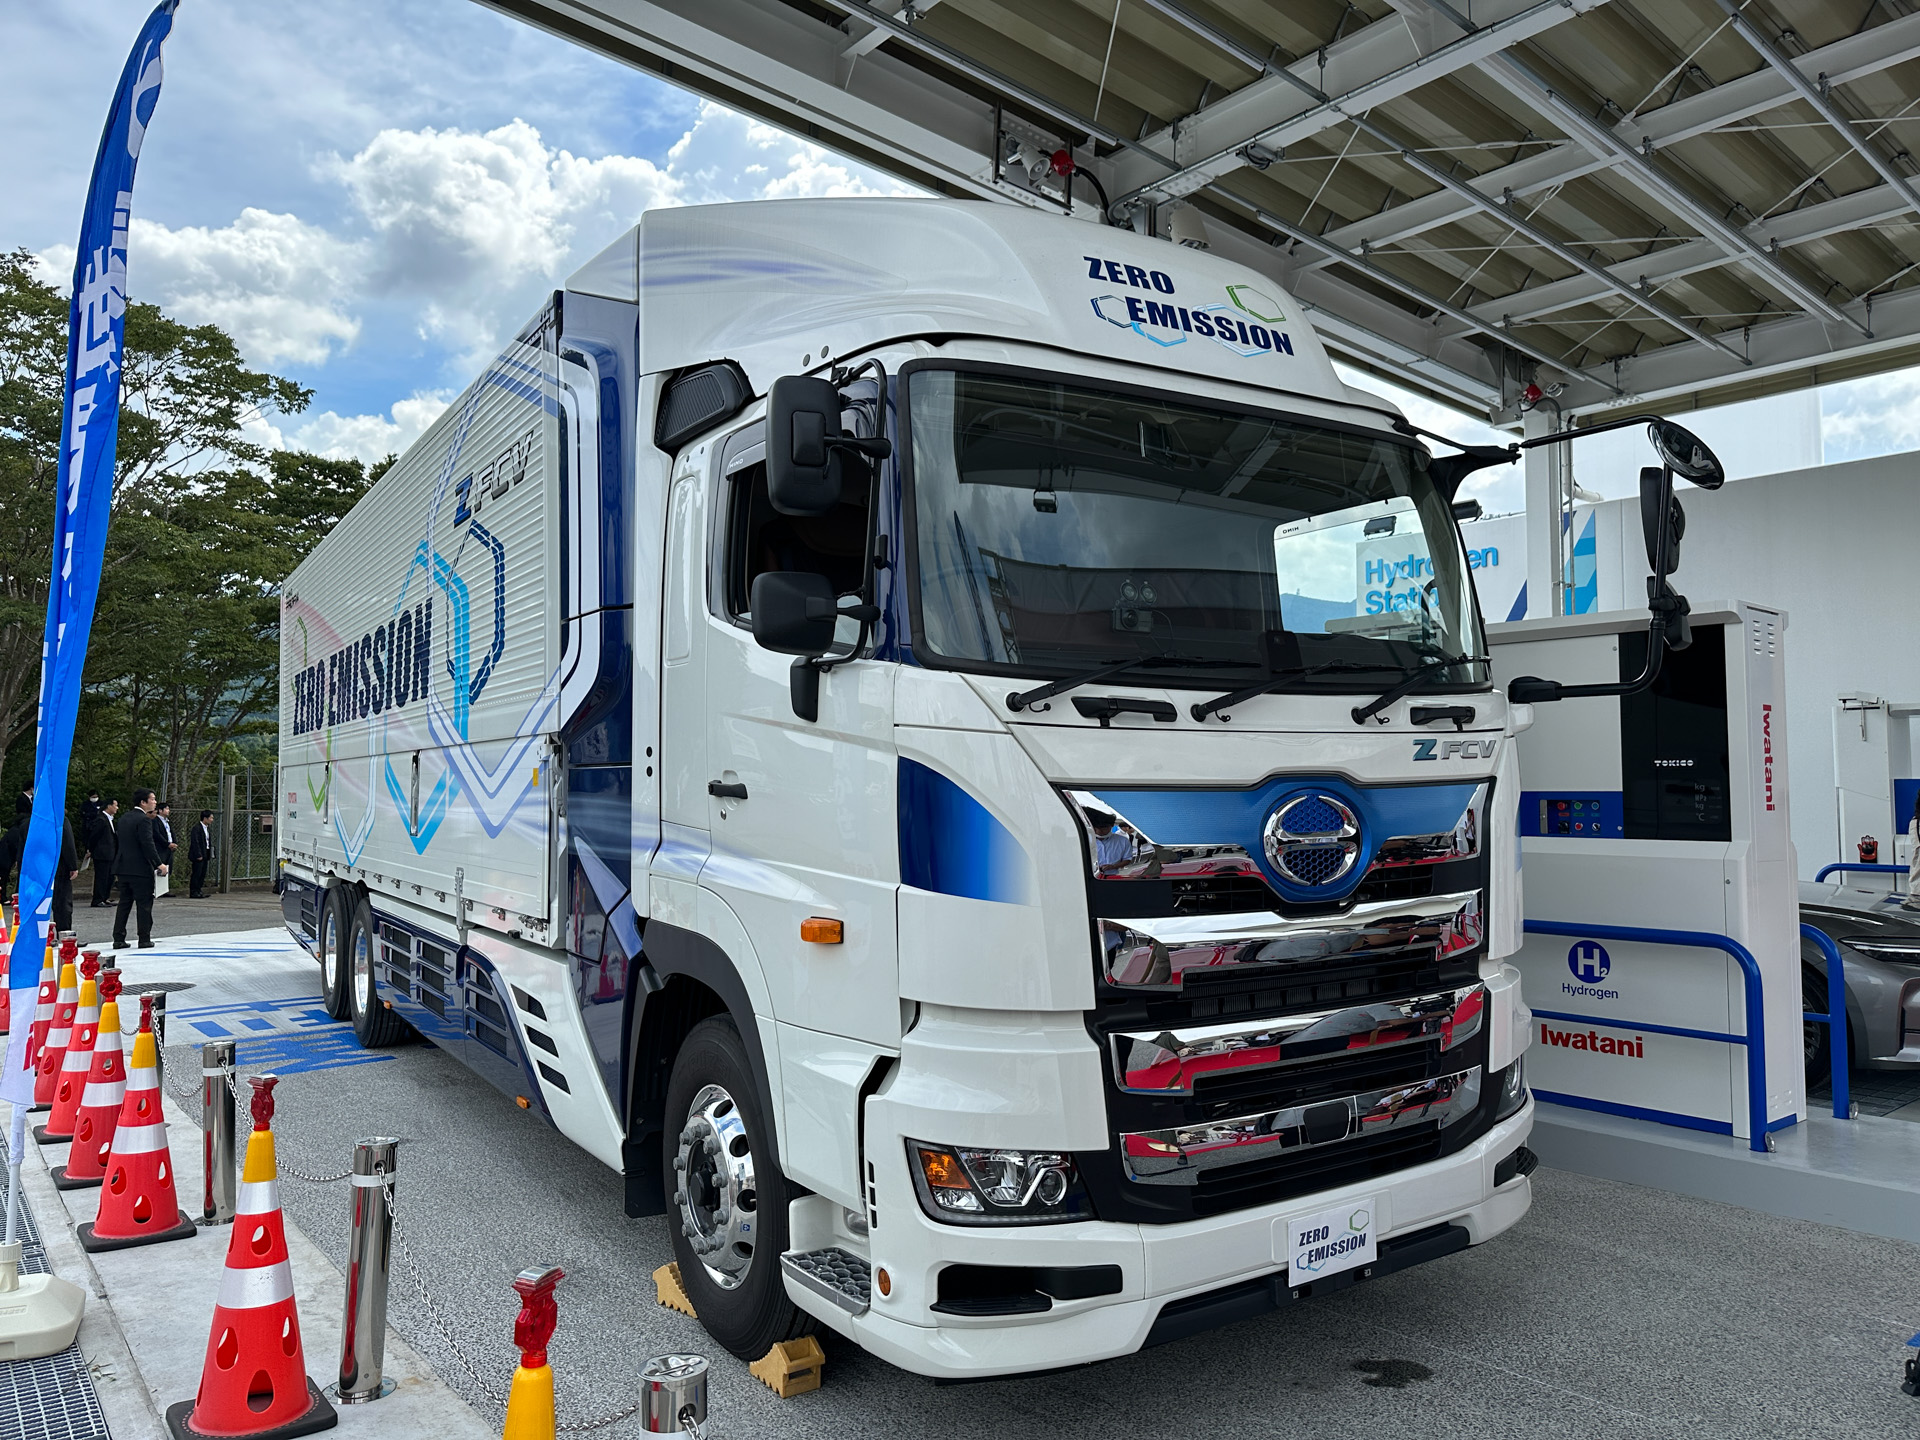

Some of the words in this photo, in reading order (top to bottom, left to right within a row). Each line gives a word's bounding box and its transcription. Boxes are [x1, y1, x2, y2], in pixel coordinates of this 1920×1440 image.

[1083, 255, 1175, 295] ZERO
[1124, 296, 1295, 356] EMISSION
[1365, 546, 1499, 589] Hydroen
[1365, 584, 1440, 615] Statio
[293, 658, 326, 736] ZERO
[328, 596, 433, 727] EMISSION
[1762, 704, 1776, 811] Iwatani
[1561, 982, 1619, 1000] Hydrogen
[1541, 1023, 1644, 1059] Iwatani
[1299, 1225, 1330, 1247] ZERO
[1307, 1232, 1367, 1264] EMISSION
